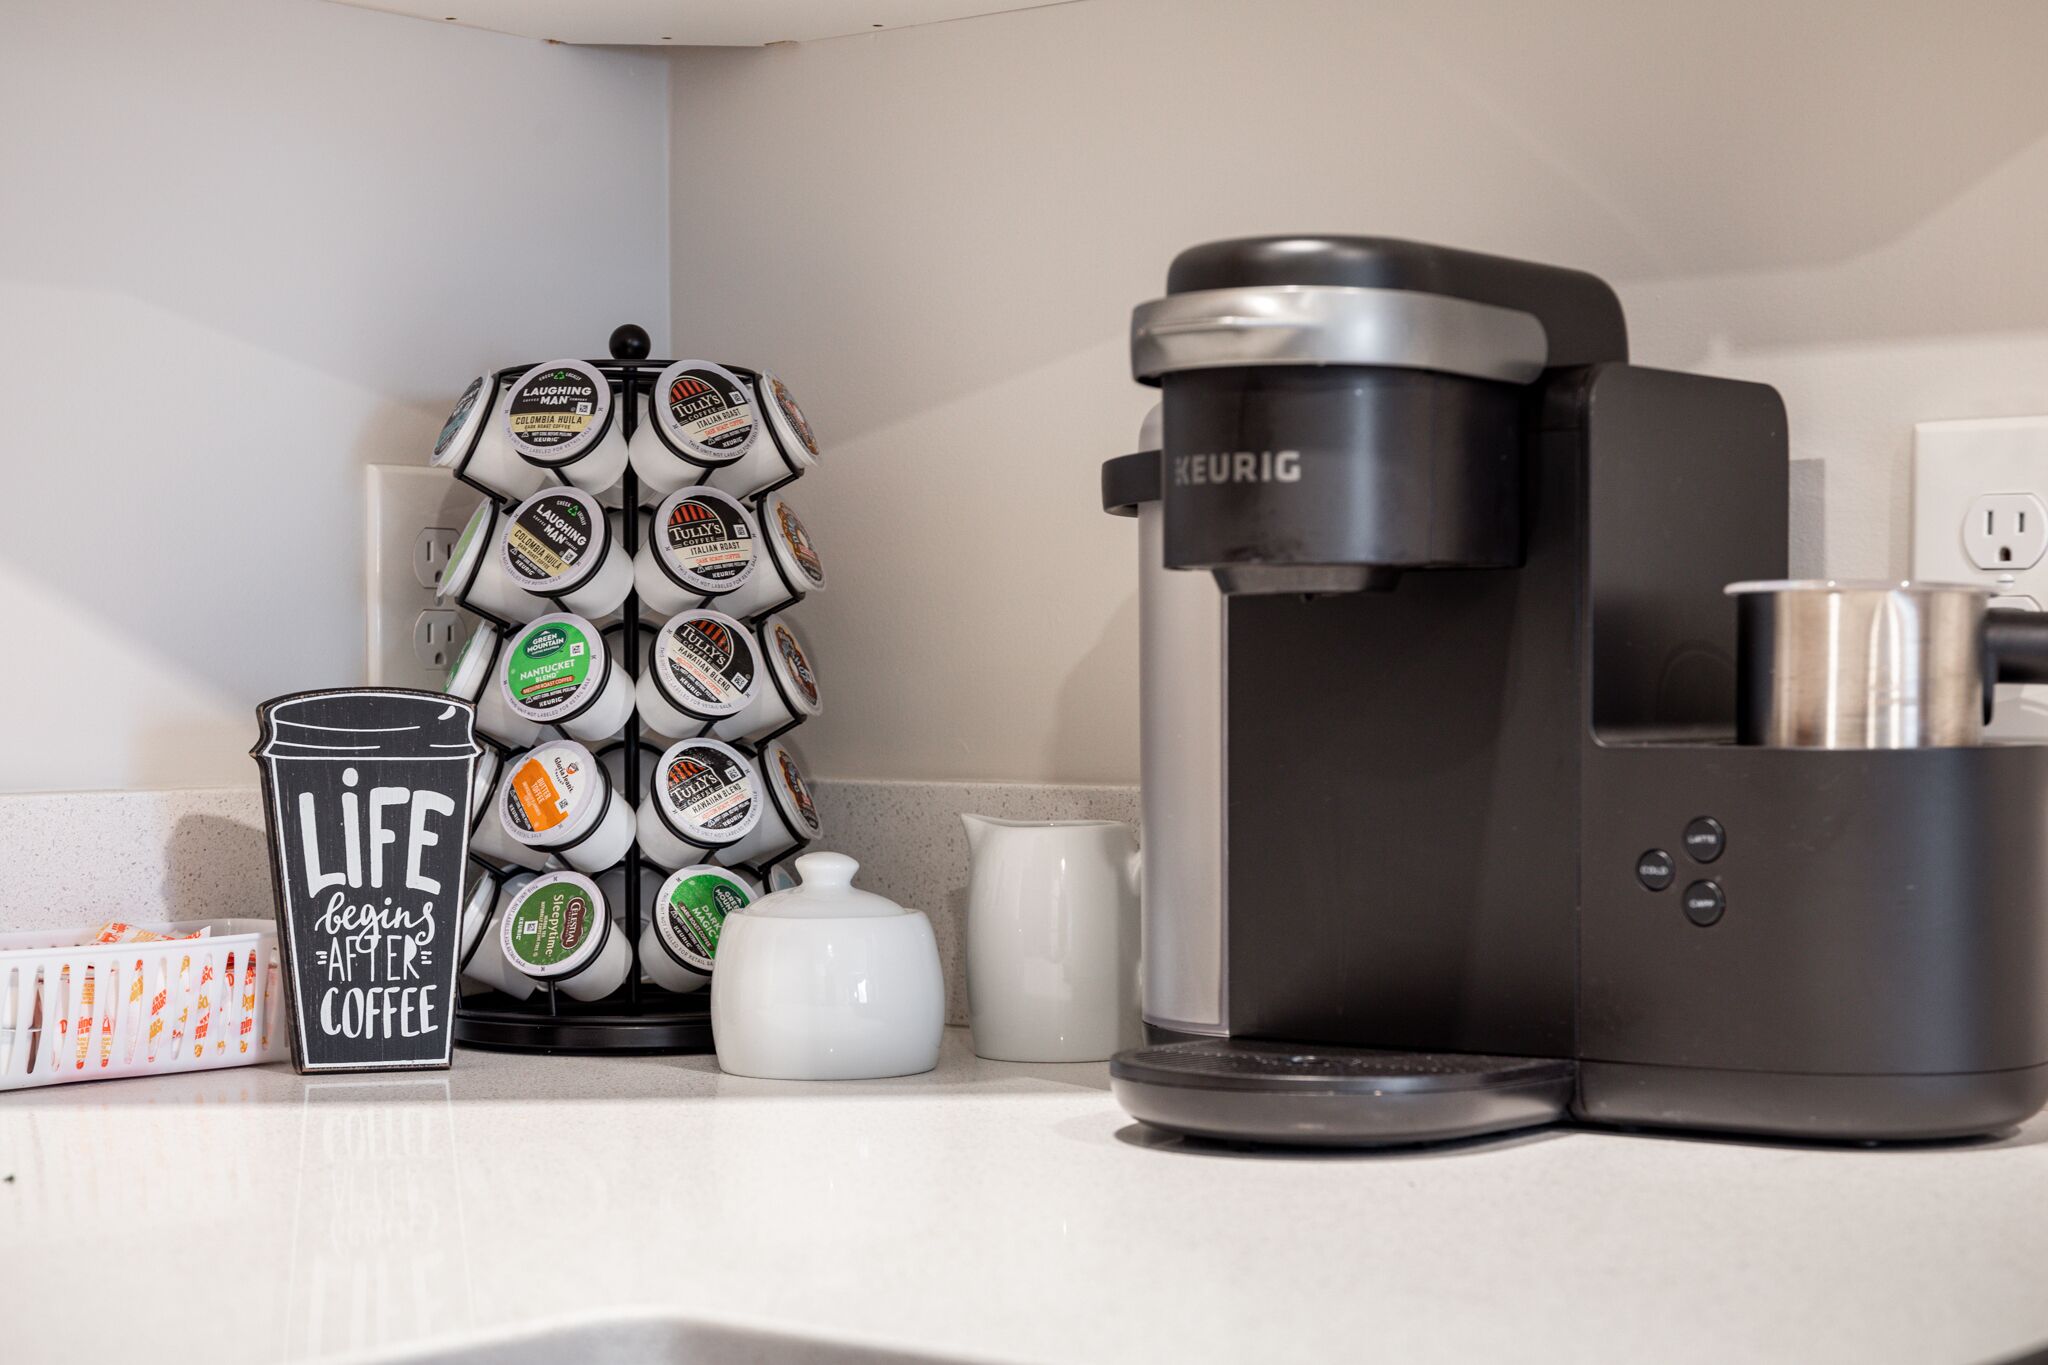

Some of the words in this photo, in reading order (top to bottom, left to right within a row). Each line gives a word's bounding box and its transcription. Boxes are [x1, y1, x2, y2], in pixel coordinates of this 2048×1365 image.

[523, 387, 592, 396] LAUGHING
[540, 396, 567, 405] MAN
[516, 416, 554, 424] COLOMBIA
[689, 407, 716, 421] COFFEE
[697, 413, 723, 428] ITALIAN
[723, 408, 741, 419] ROAST
[722, 437, 743, 447] KEURIG
[724, 449, 743, 457] LABELED
[1175, 451, 1301, 486] KEURIG
[536, 504, 586, 546] LAUGHING
[544, 524, 566, 544] MAN
[514, 530, 546, 557] COLOMBIA
[544, 553, 562, 570] HUILA
[683, 537, 714, 546] COFFEE
[691, 544, 718, 555] ITALIAN
[720, 542, 740, 550] ROAST
[515, 559, 535, 576] KEURIG
[527, 638, 564, 653] MOUNTAIN
[533, 633, 557, 644] GREEN
[683, 640, 712, 663] COFFEE
[520, 659, 575, 680] NANTUCKET
[535, 672, 556, 682] BLEND
[678, 647, 710, 674] HAWAIIAN
[710, 671, 731, 691] BLEND
[680, 677, 702, 696] KEURIG
[539, 697, 563, 707] KEURIG
[538, 710, 559, 718] LABELED
[555, 757, 565, 776] Gloria
[531, 783, 545, 804] TOFFEE
[536, 778, 552, 799] BUTTER
[687, 786, 715, 806] COFFEE
[692, 794, 722, 814] HAWAIIAN
[722, 783, 742, 797] BLEND
[715, 889, 733, 912] MOUN
[725, 891, 739, 910] GREE
[314, 891, 435, 954] begins
[545, 894, 564, 955] Sleepytime
[565, 902, 581, 944] CELESTIAL
[680, 906, 691, 919] DARK
[688, 917, 701, 932] ROAST
[697, 930, 713, 948] COFFEE
[692, 908, 716, 937] MAGIC
[702, 905, 722, 931] DARK
[664, 927, 678, 948] LABELED
[678, 947, 689, 956] FOR
[688, 955, 705, 965] RETAIL
[674, 926, 693, 948] KEURIG
[328, 935, 420, 982] AFTER
[320, 984, 438, 1039] COFFEE
